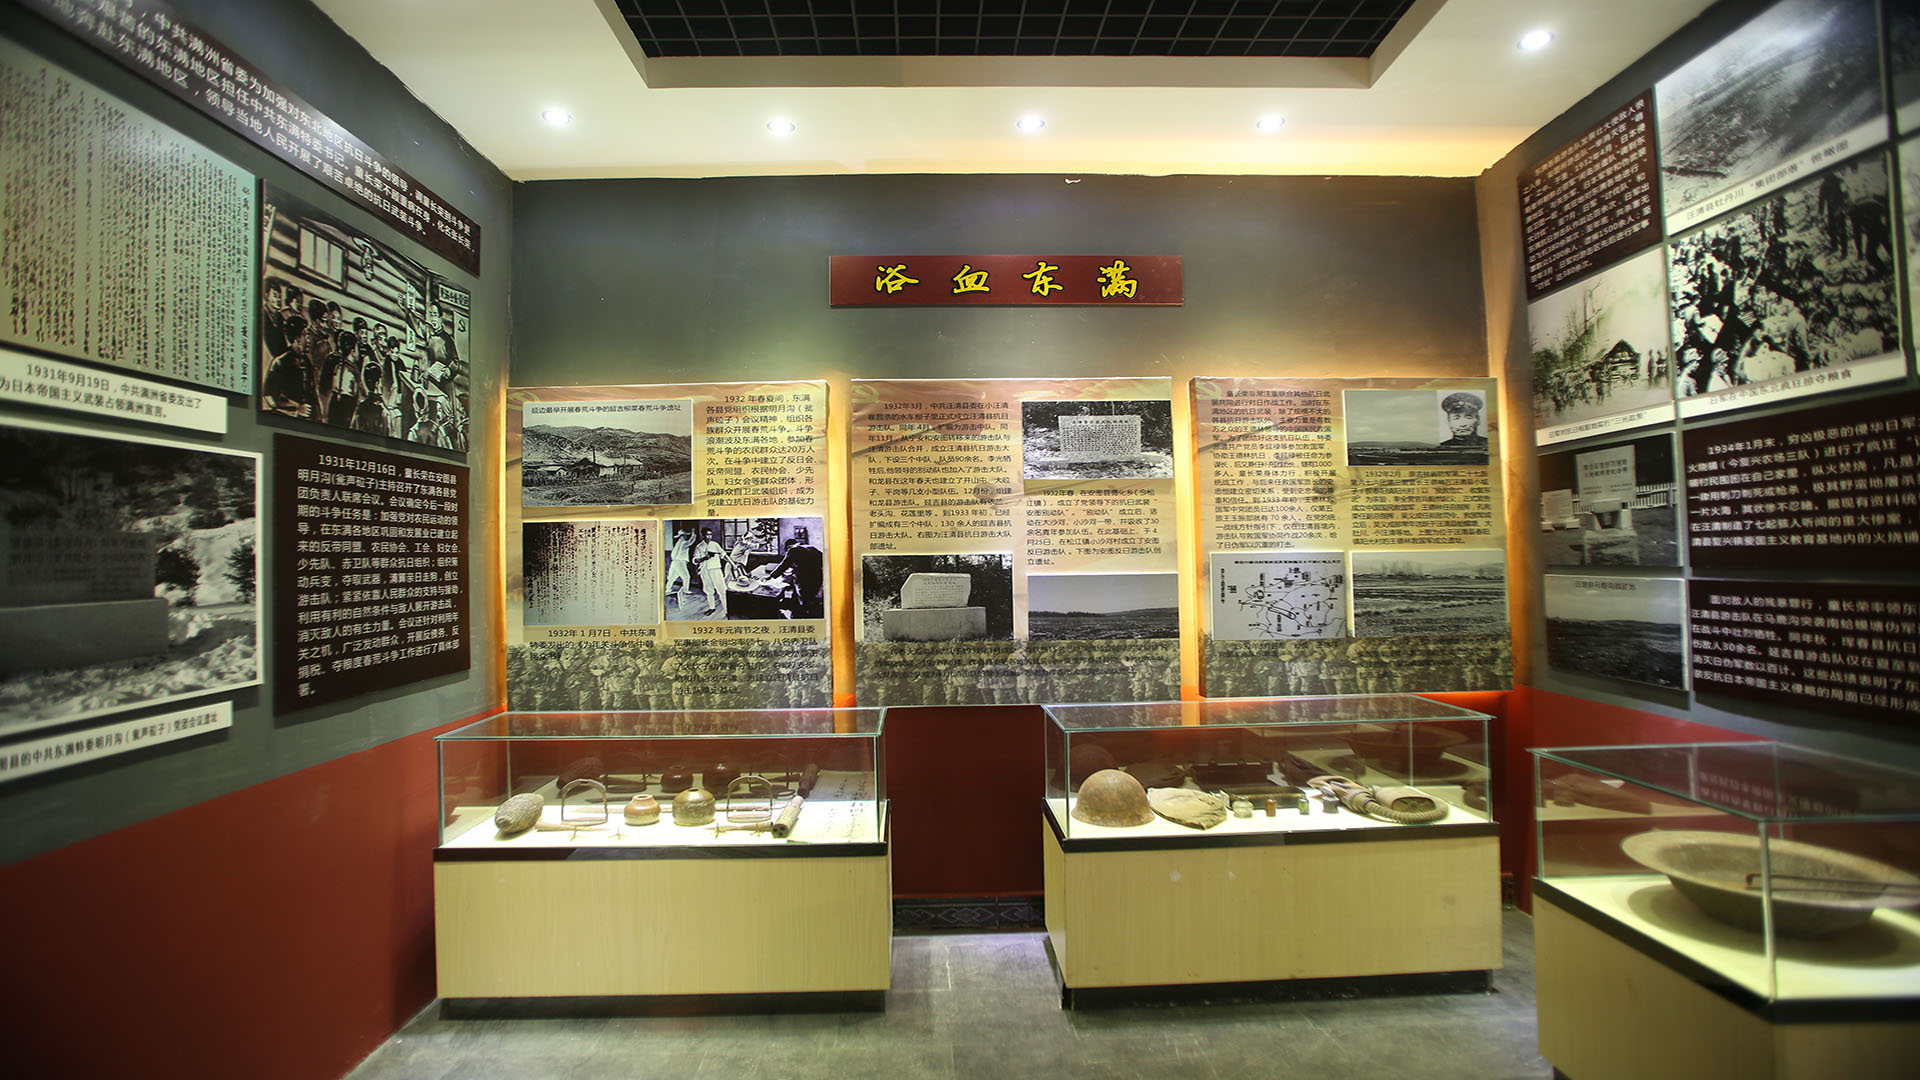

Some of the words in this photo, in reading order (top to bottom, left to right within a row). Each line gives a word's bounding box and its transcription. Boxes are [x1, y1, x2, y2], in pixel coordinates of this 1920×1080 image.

[125, 0, 472, 237] ，中共满洲省委为加强对东北地区抗日斗争的领导，调童长荣到斗争更
[874, 260, 1138, 298] 浴血东满
[1708, 416, 1920, 455] 1934年1月末，穷凶极恶的侵华日军
[1690, 473, 1920, 501] 一律用刺刀刺死或枪杀，极其野蛮地屠杀
[706, 508, 720, 517] 量。
[548, 628, 656, 638] 1932年1月7日，中共东满
[692, 625, 815, 635] 1932年元宵节之夜，汪清县委
